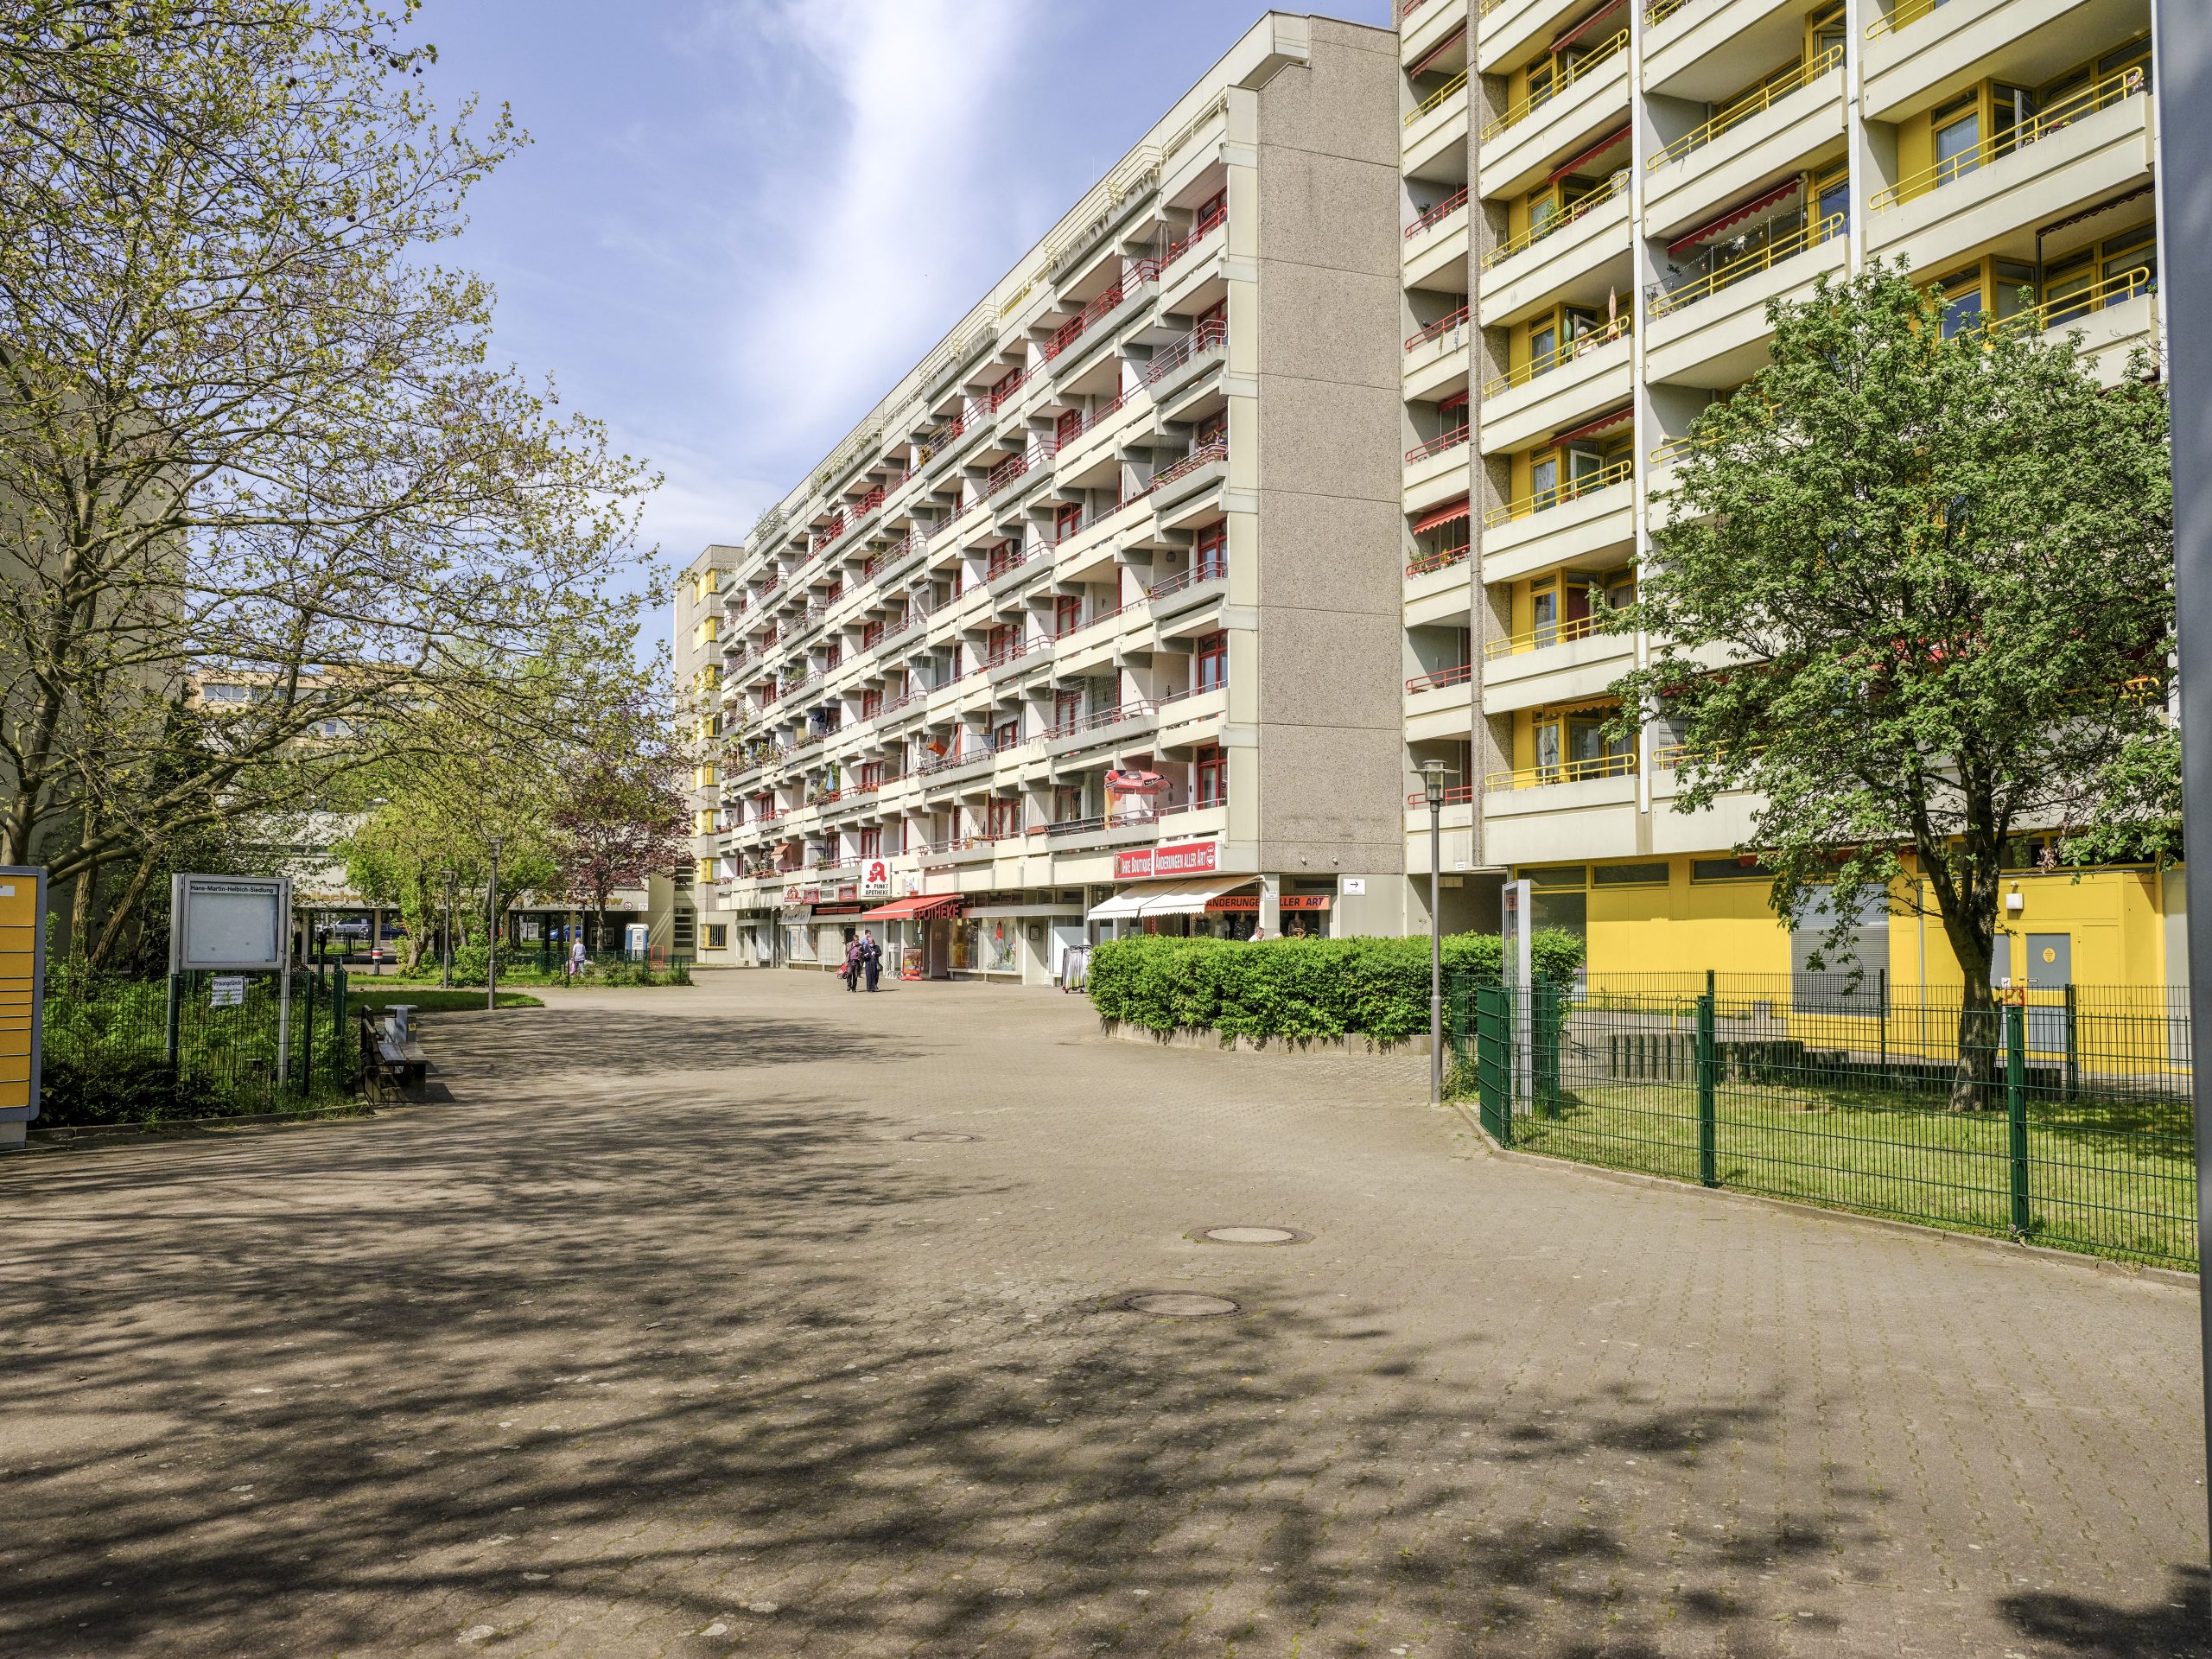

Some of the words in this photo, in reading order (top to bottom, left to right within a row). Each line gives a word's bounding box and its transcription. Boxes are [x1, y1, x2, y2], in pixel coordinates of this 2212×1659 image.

[1184, 853, 1197, 868] ALLER
[1197, 849, 1206, 867] ART
[1279, 898, 1300, 906] LLER
[1306, 898, 1324, 906] ART
[912, 904, 959, 921] APOTHEKE
